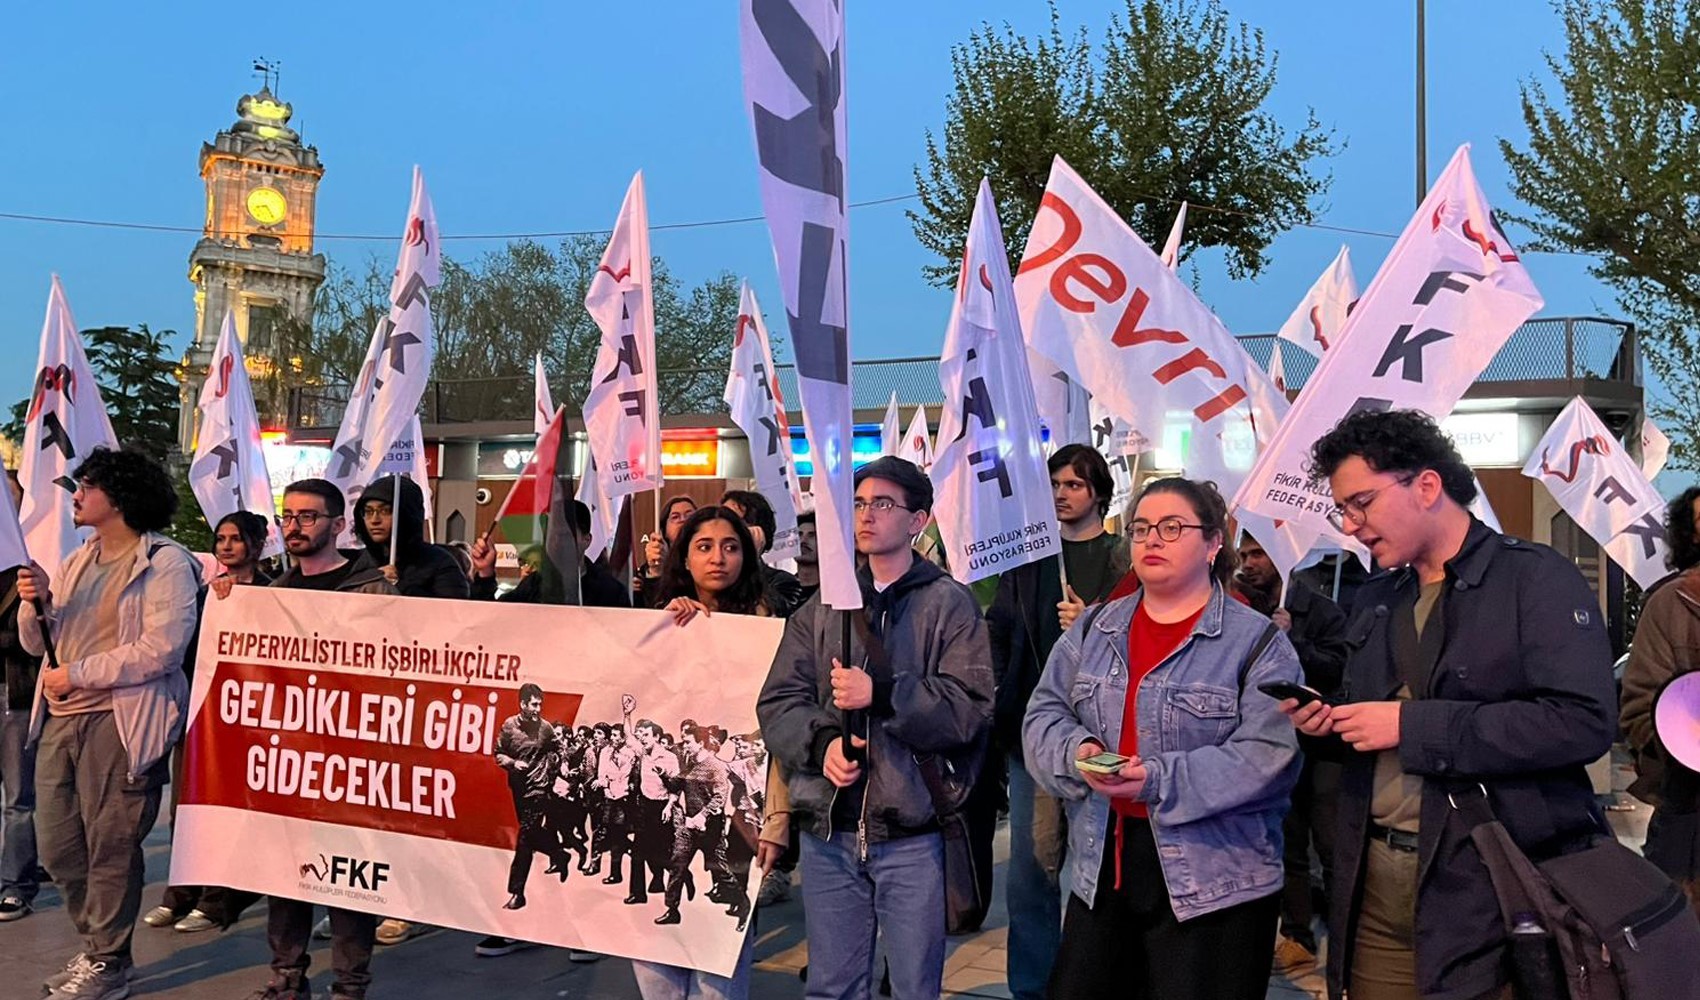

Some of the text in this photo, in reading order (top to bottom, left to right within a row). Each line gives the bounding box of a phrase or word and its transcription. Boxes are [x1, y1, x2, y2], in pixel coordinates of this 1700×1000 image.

[1018, 191, 1248, 423] Devri
[1266, 489, 1334, 516] FEDERASY
[218, 631, 521, 683] EMPERYALİSTLER İŞBİRLİKÇİLER
[220, 674, 498, 756] GELDİKLERİ GİBİ
[246, 734, 457, 819] GİDECEKLER
[330, 855, 390, 891] FKF
